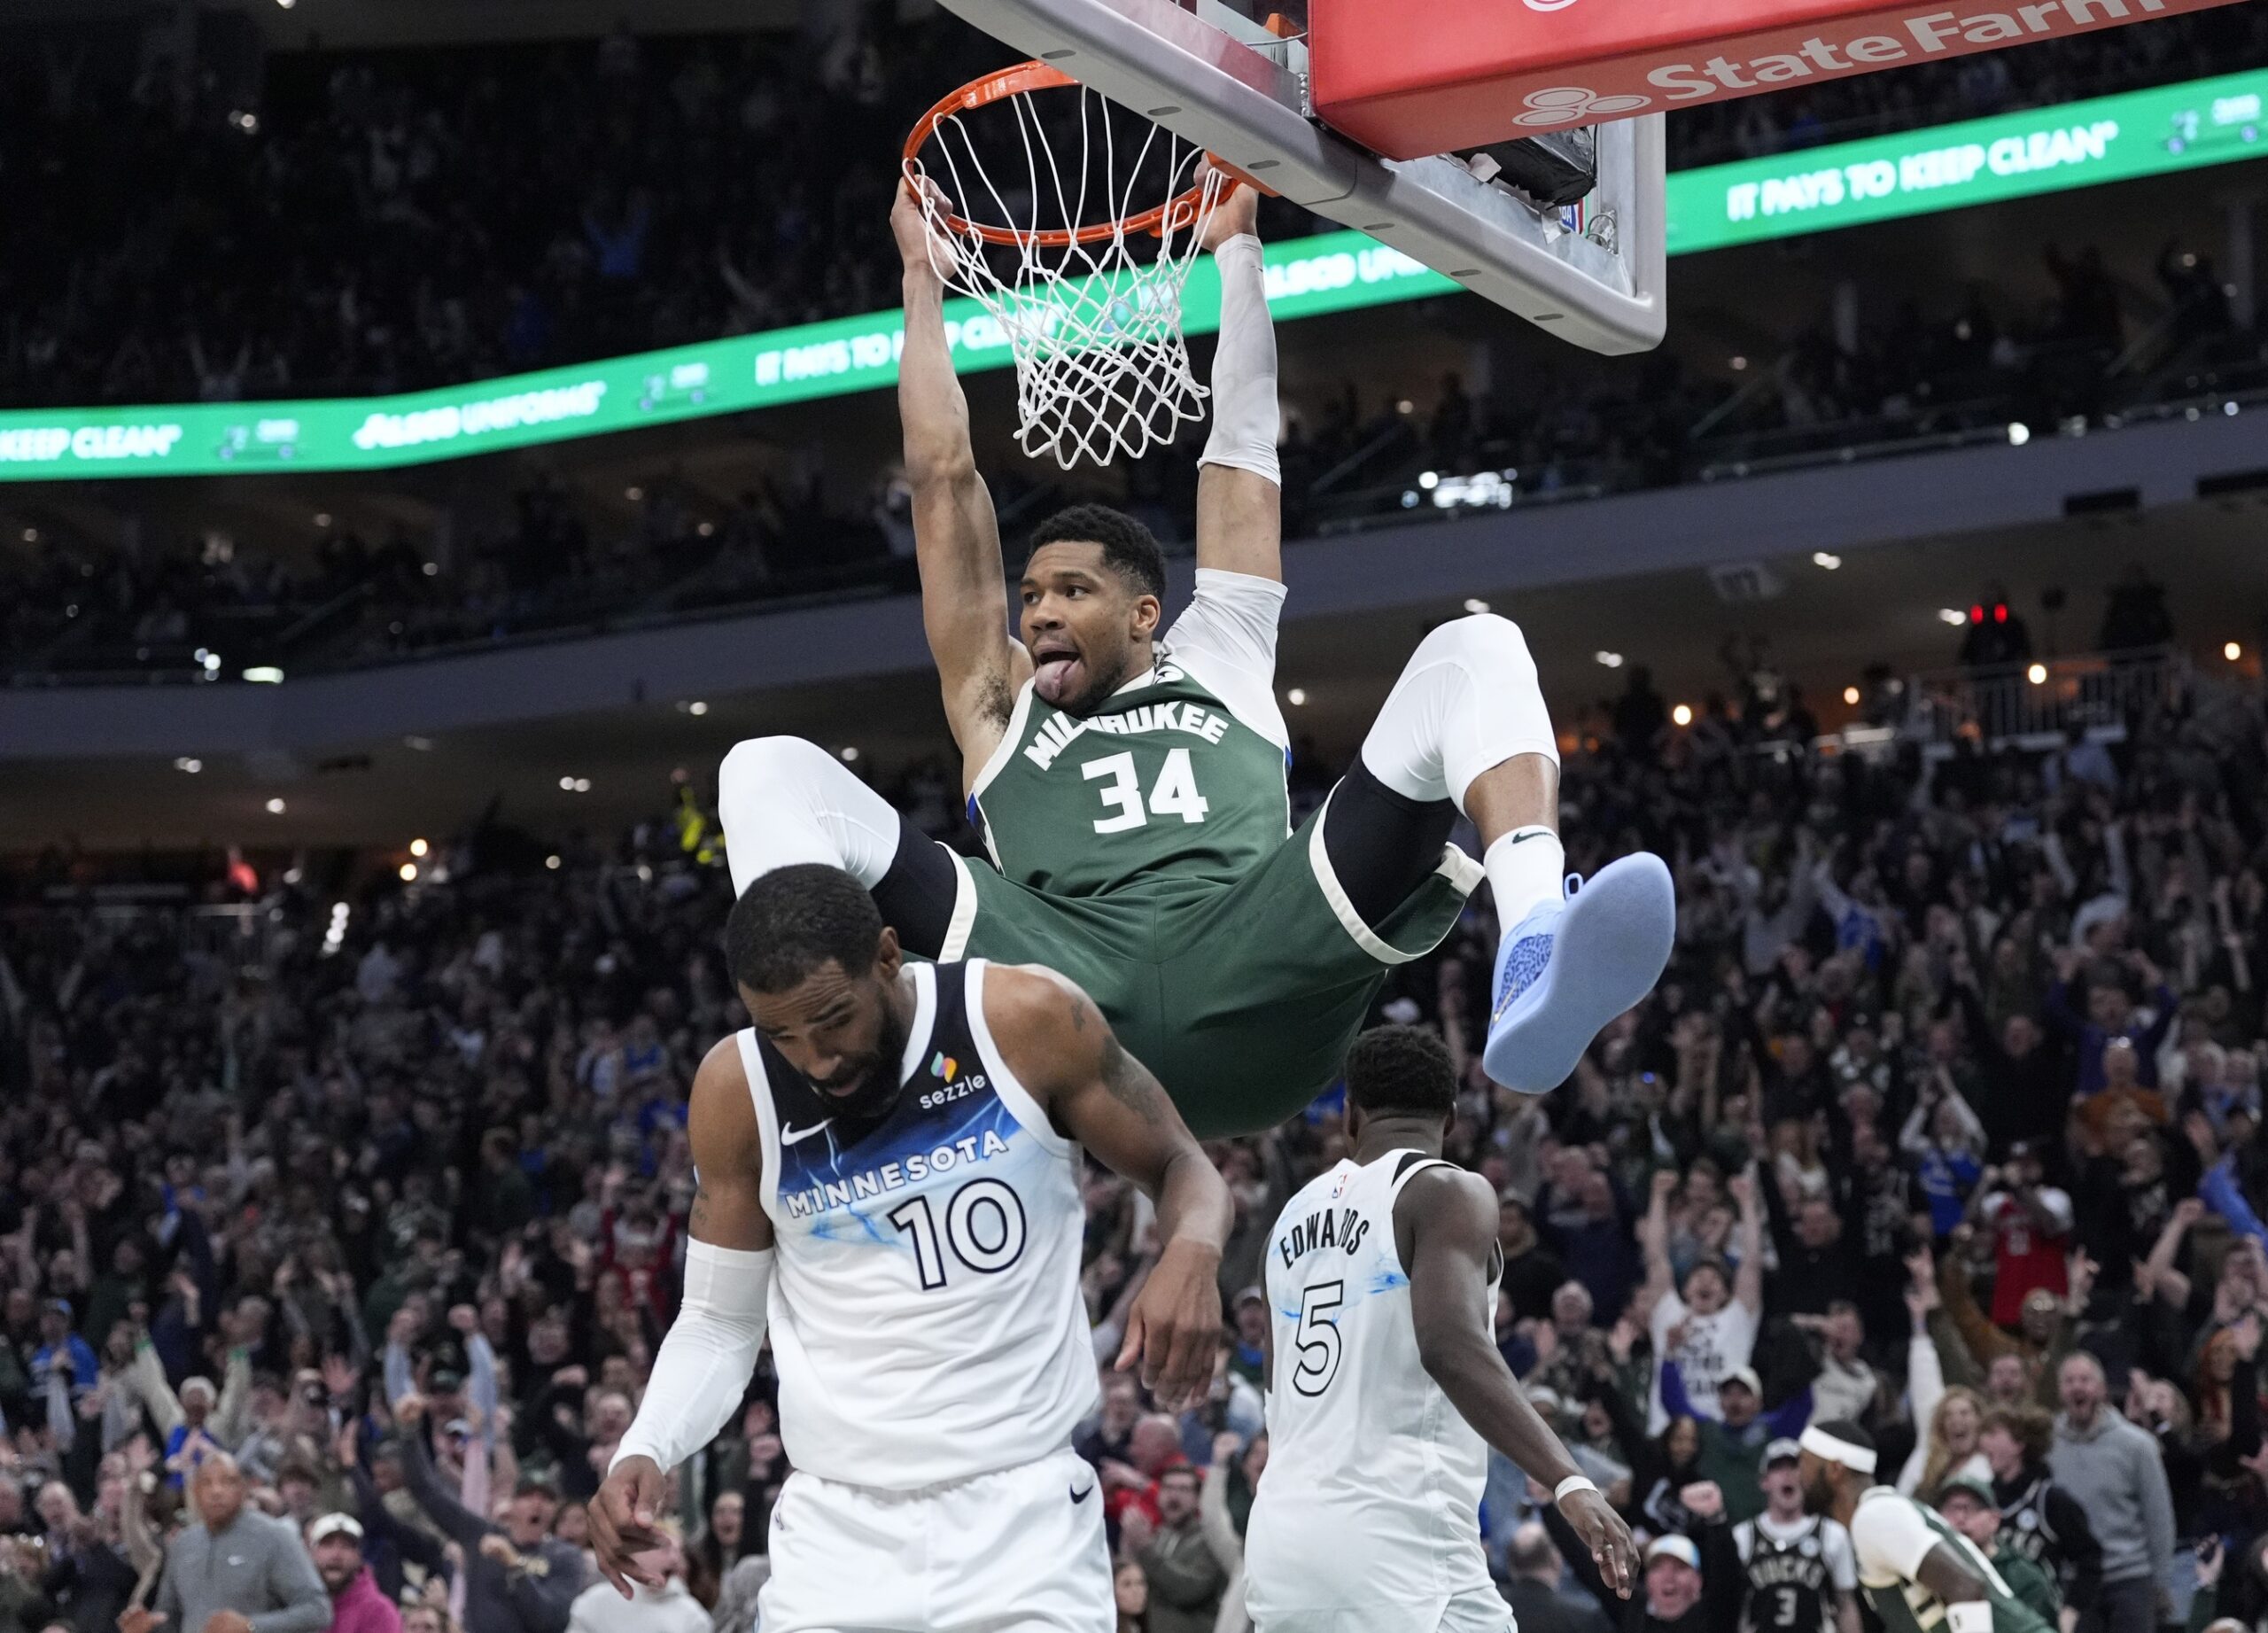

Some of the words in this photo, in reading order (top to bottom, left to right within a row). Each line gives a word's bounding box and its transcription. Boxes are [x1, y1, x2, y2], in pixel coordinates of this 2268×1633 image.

[1727, 181, 1759, 222] IT
[1844, 159, 1897, 201] TO
[1080, 748, 1209, 834] 34
[919, 1073, 986, 1109] sezzle
[785, 1130, 1009, 1219] MINNESOTA
[886, 1177, 1028, 1291] 10
[1293, 1279, 1344, 1397] 5
[1774, 1588, 1798, 1626] 3
